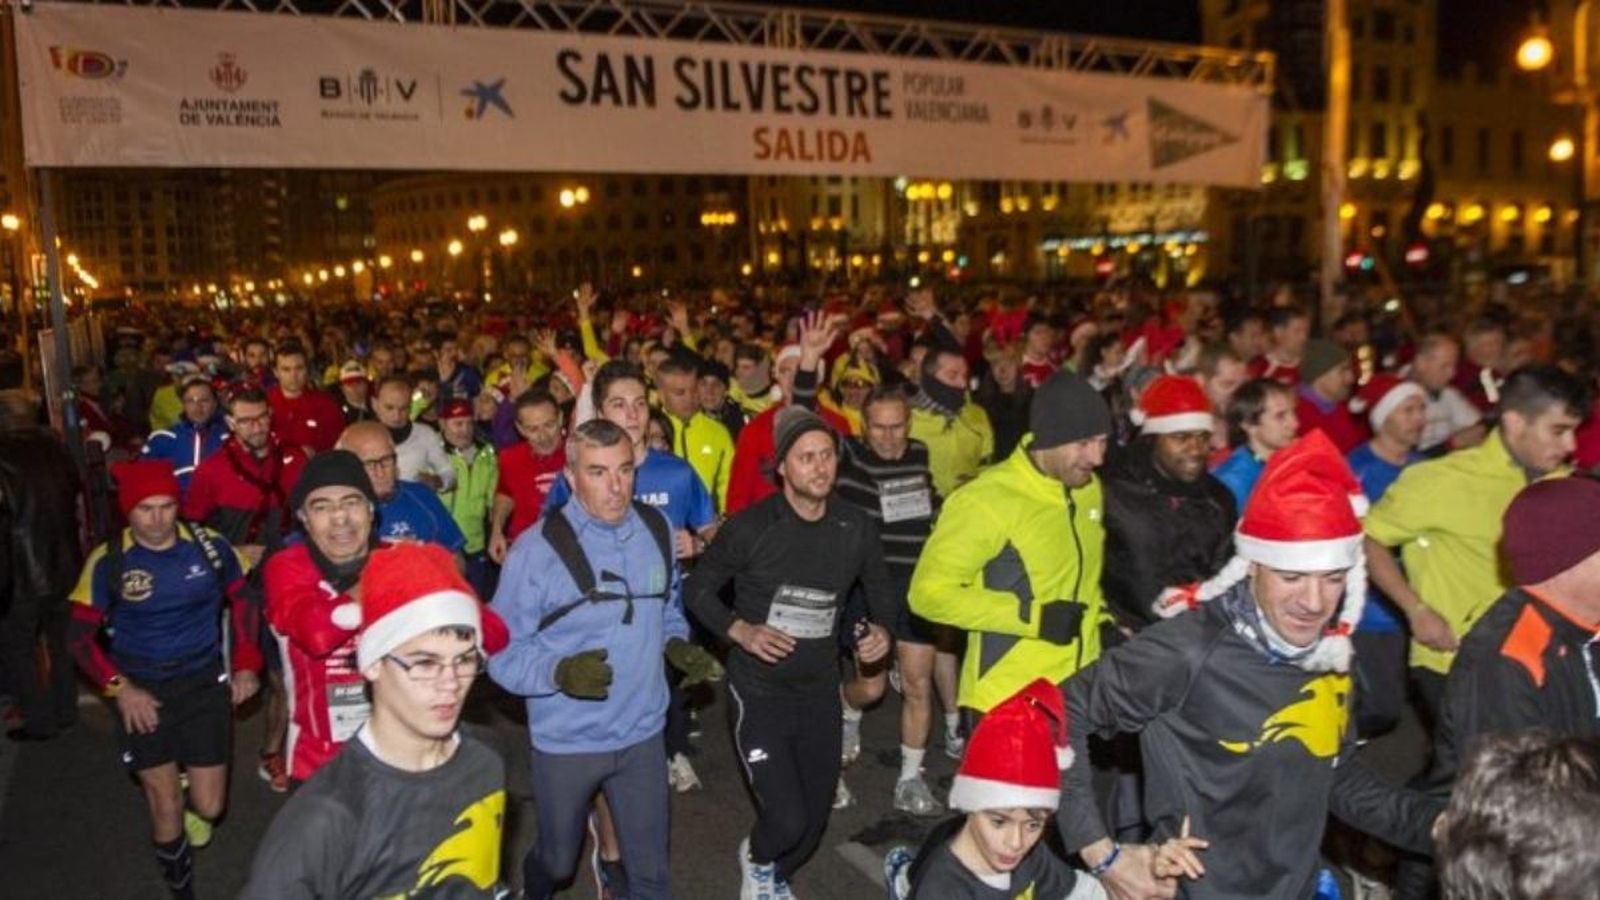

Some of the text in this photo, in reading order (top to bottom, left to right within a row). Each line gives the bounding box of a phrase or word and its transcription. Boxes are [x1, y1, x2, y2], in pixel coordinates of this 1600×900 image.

[556, 49, 893, 119] SAN SILVESTRE
[902, 71, 965, 96] POPULAR
[179, 98, 280, 113] AJUNTAMENT
[179, 112, 201, 126] DE
[752, 126, 873, 163] SALIDA
